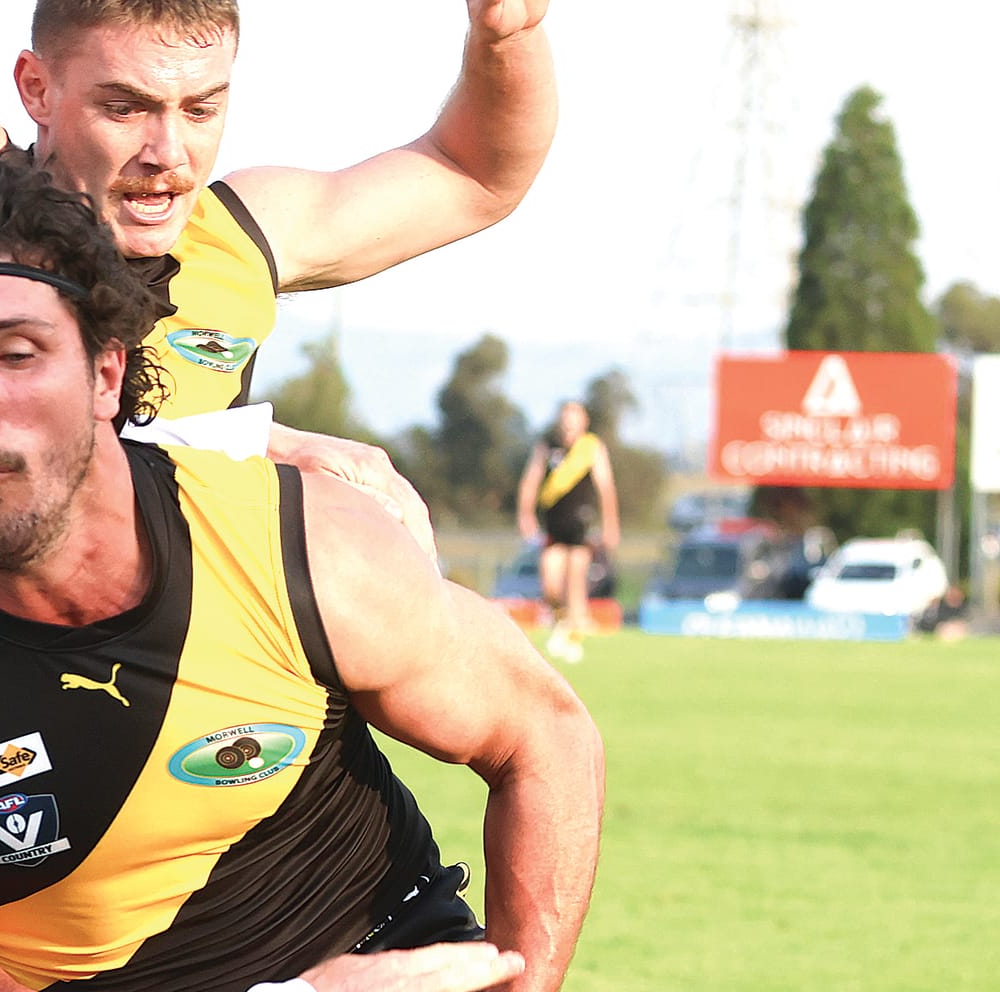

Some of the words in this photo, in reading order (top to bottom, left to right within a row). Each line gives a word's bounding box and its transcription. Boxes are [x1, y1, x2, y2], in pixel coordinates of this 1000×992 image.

[205, 726, 255, 744] MORWELL
[215, 774, 258, 786] BOWLING
[258, 765, 280, 779] CLUB
[1, 844, 53, 863] COUNTRY
